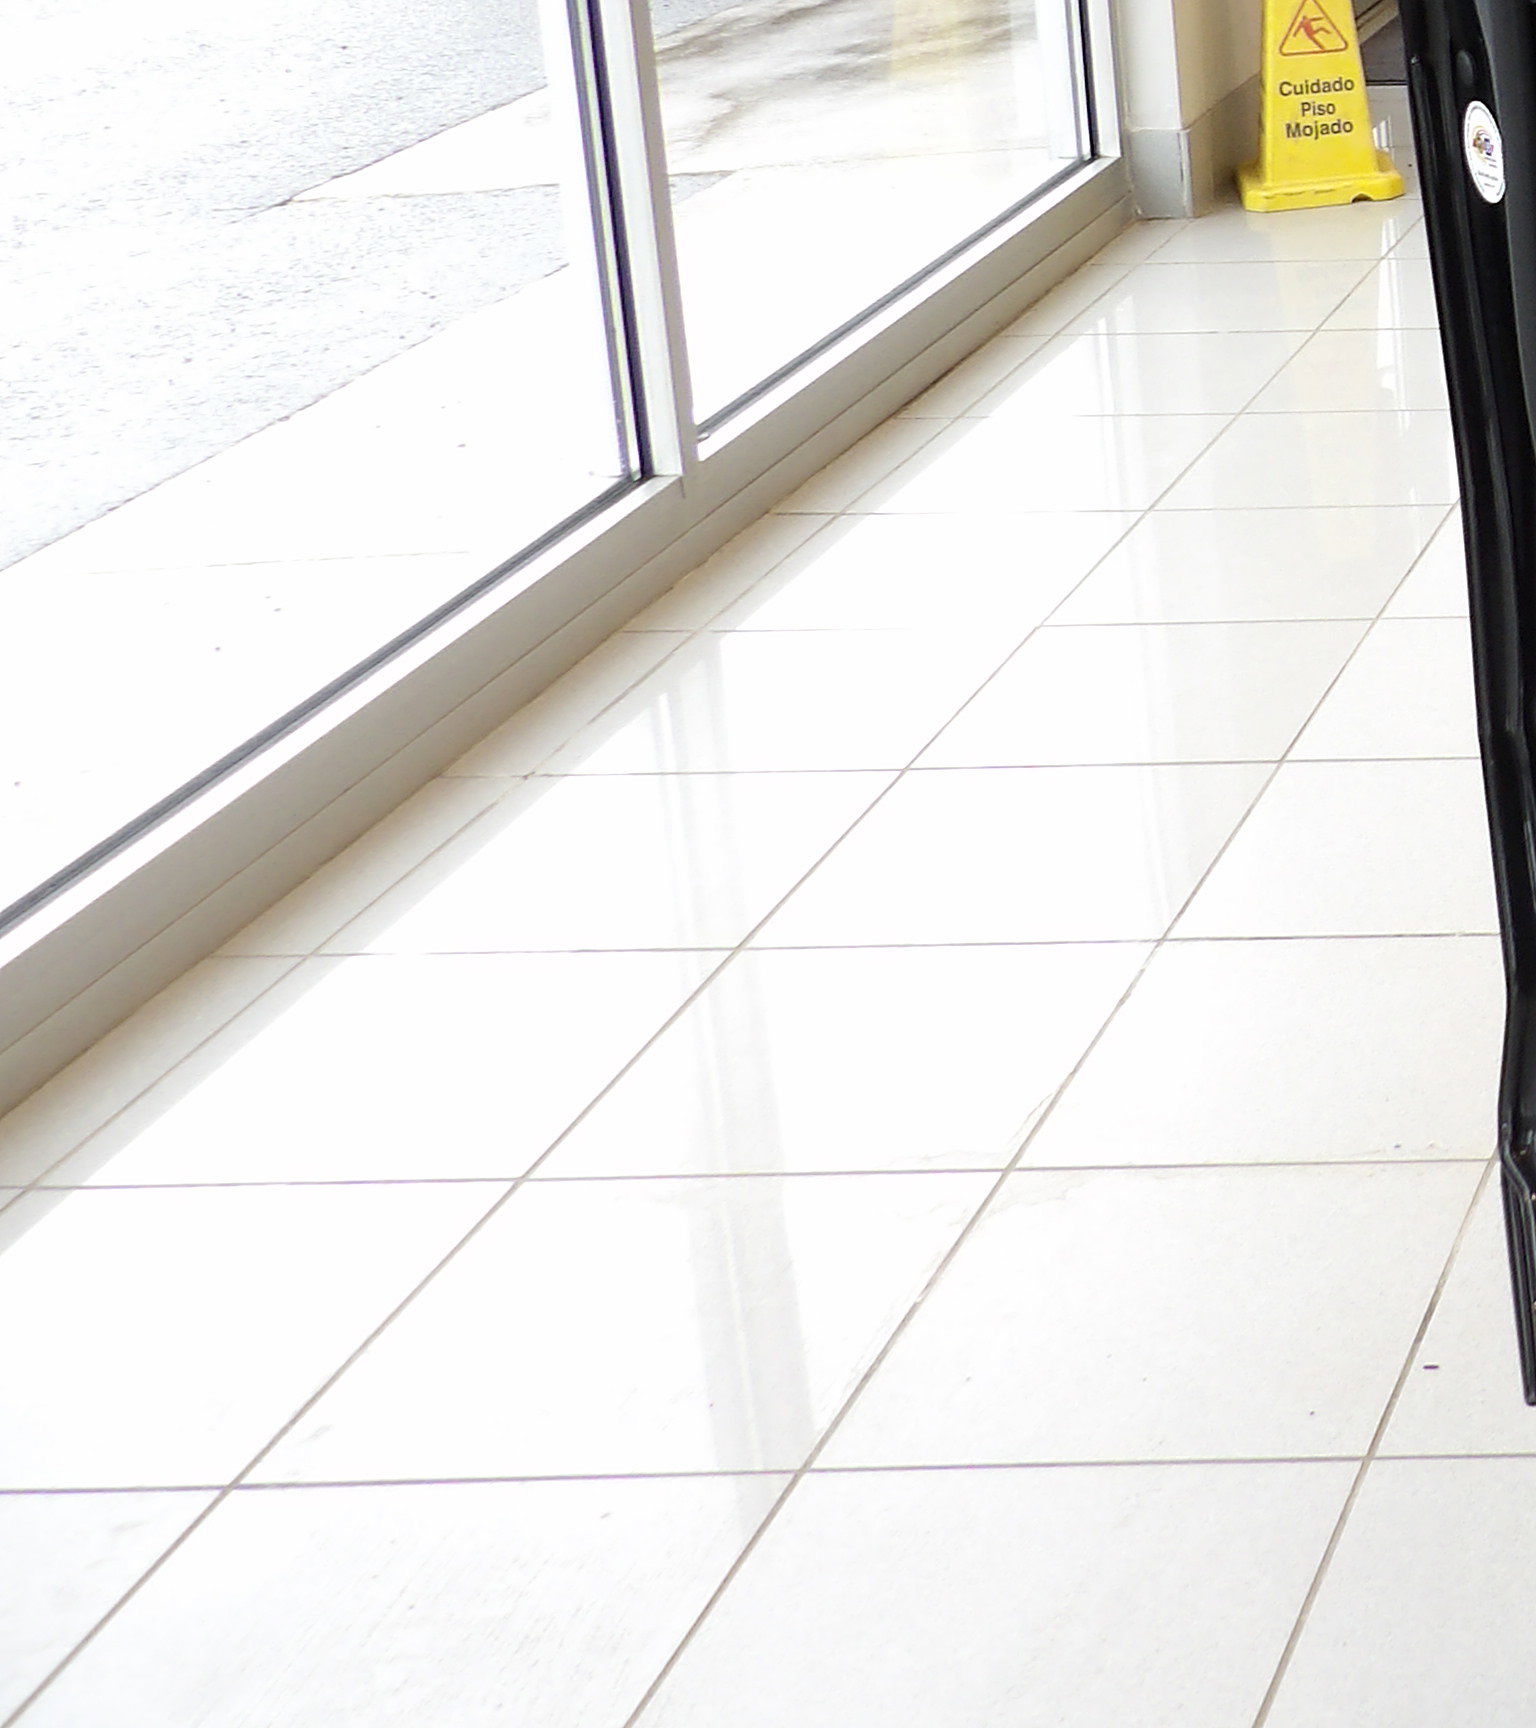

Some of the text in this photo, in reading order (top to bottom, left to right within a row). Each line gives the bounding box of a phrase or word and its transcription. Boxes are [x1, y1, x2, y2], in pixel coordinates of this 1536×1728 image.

[1279, 76, 1355, 97] Cuidado
[1300, 101, 1336, 117] Piso
[1285, 118, 1354, 140] Mojado
